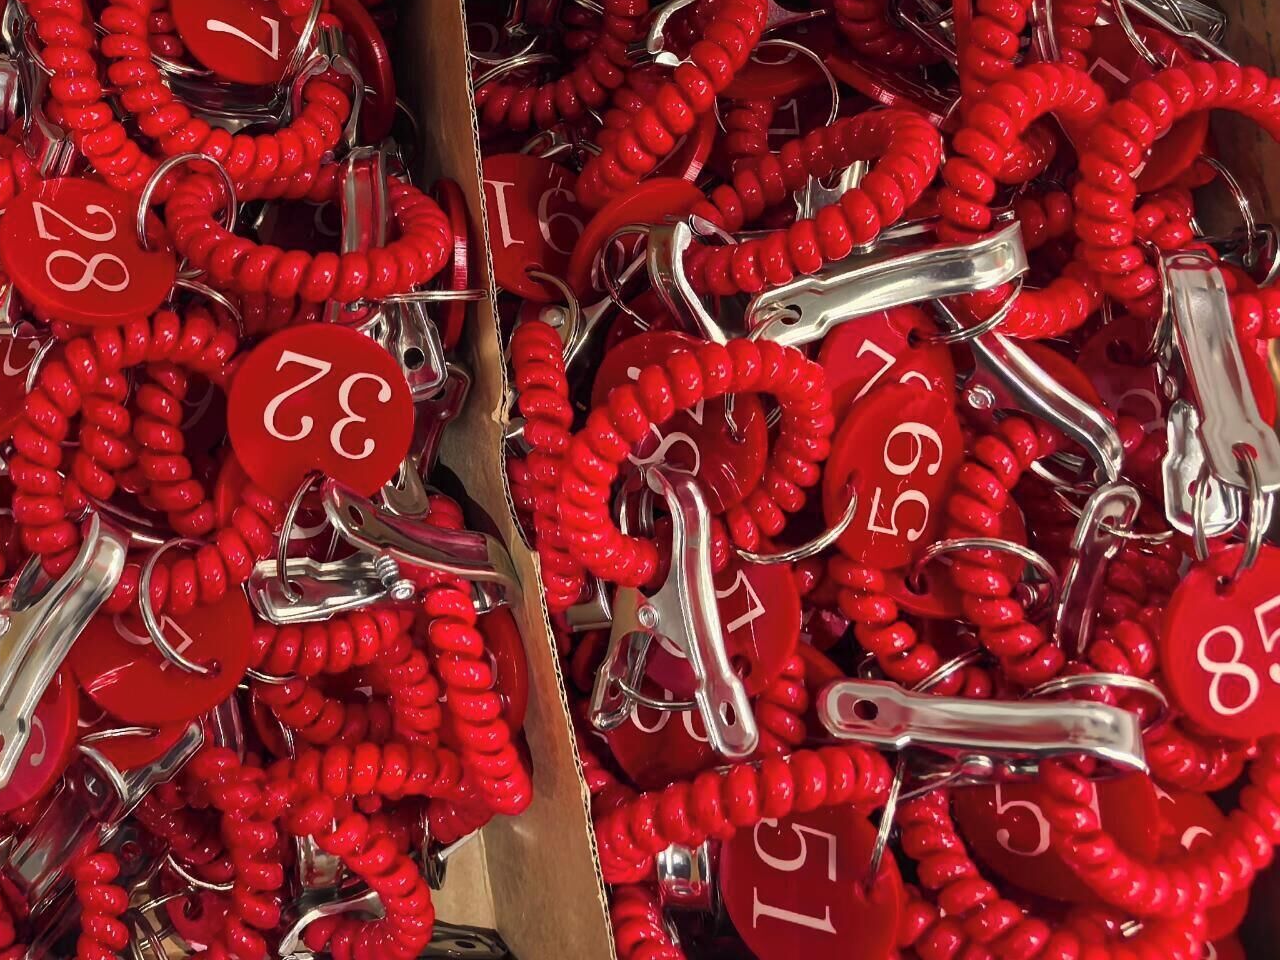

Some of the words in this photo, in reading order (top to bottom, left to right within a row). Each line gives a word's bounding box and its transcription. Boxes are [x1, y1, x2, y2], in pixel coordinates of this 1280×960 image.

[33, 201, 130, 293] 28
[263, 350, 392, 460] 32
[867, 421, 943, 542] 59
[753, 817, 837, 935] 51
